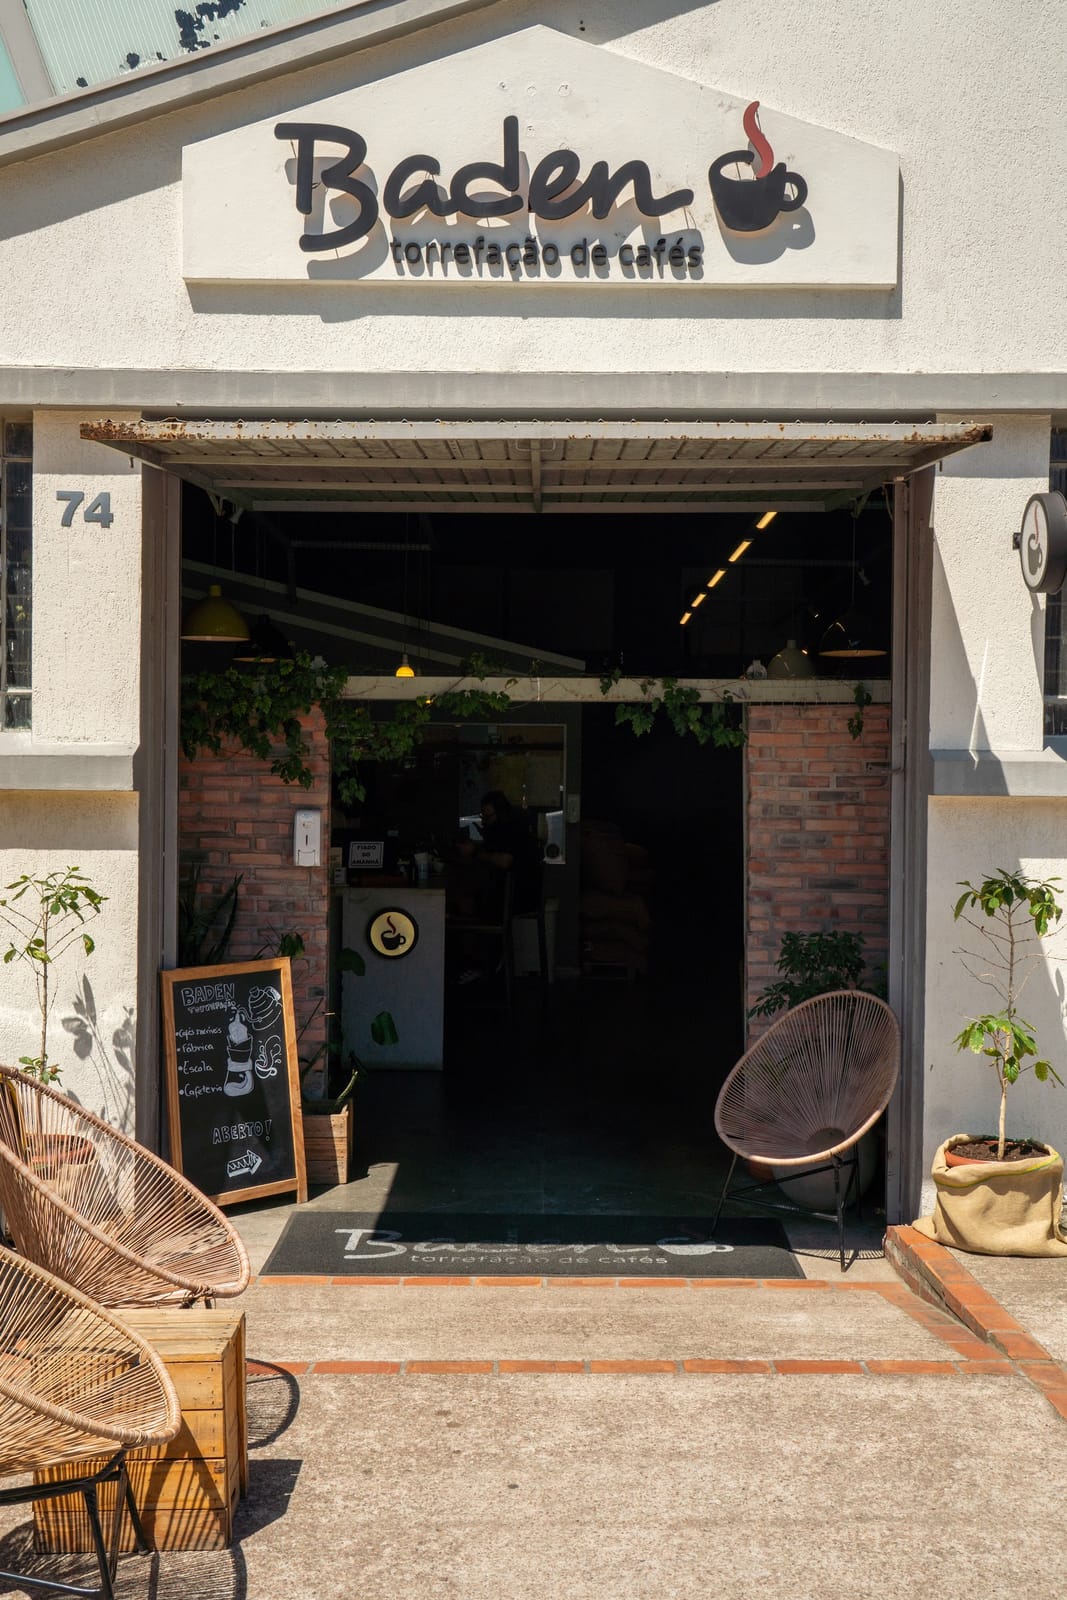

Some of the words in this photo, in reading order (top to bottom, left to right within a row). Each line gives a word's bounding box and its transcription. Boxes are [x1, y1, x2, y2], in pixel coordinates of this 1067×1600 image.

[274, 115, 694, 252] Baden
[390, 235, 560, 271] torrefação
[570, 237, 607, 266] de
[618, 237, 703, 268] cafés
[56, 491, 114, 528] 74
[181, 983, 235, 1006] BADEN
[183, 1060, 214, 1074] Escola
[184, 1083, 222, 1098] Cafeteria
[212, 1119, 272, 1144] ABERTO!
[559, 1255, 589, 1264] de
